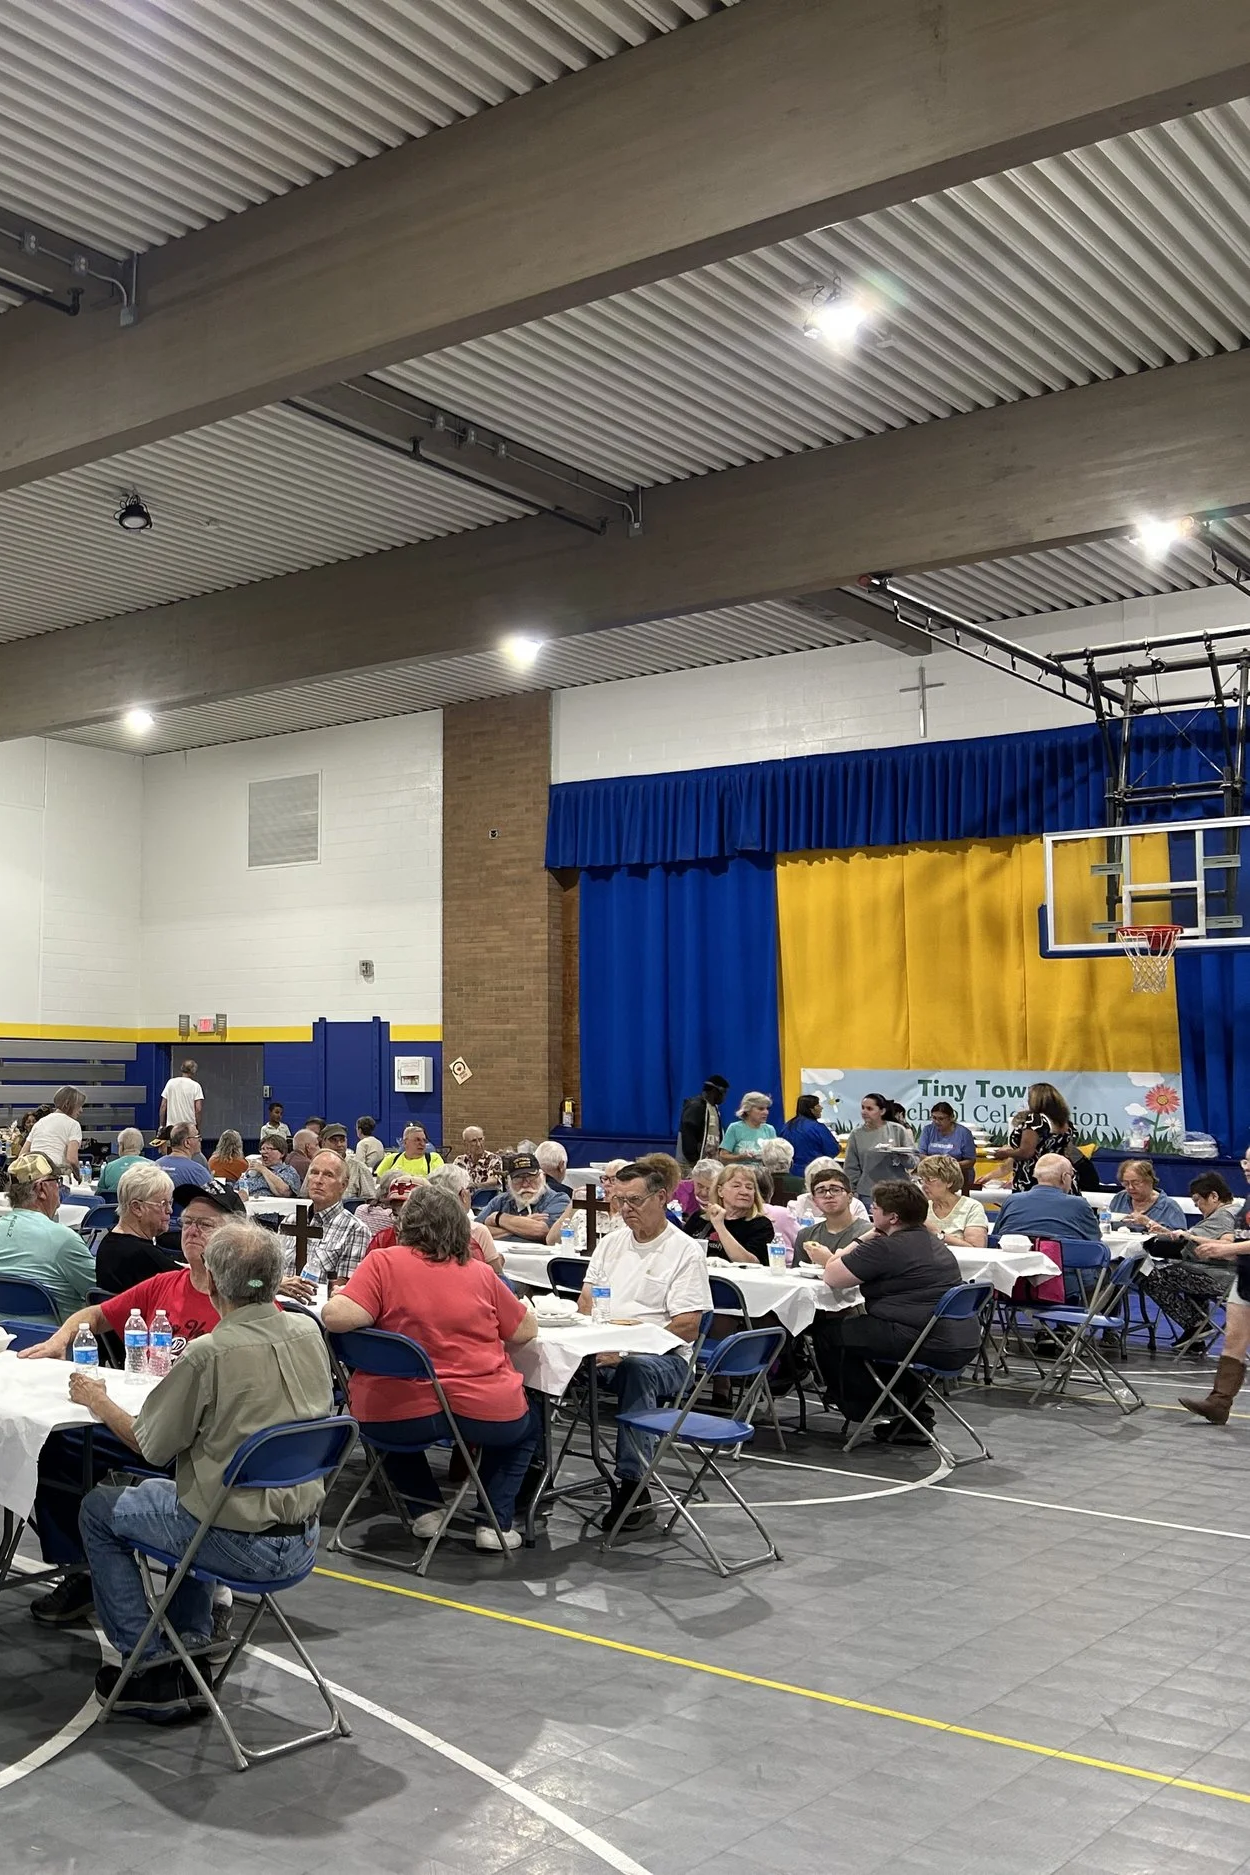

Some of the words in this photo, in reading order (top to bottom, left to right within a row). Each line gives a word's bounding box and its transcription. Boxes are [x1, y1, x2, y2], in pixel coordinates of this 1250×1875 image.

[917, 1079, 967, 1102] Tiny
[975, 1080, 1027, 1098] Tow
[906, 1102, 966, 1122] chl
